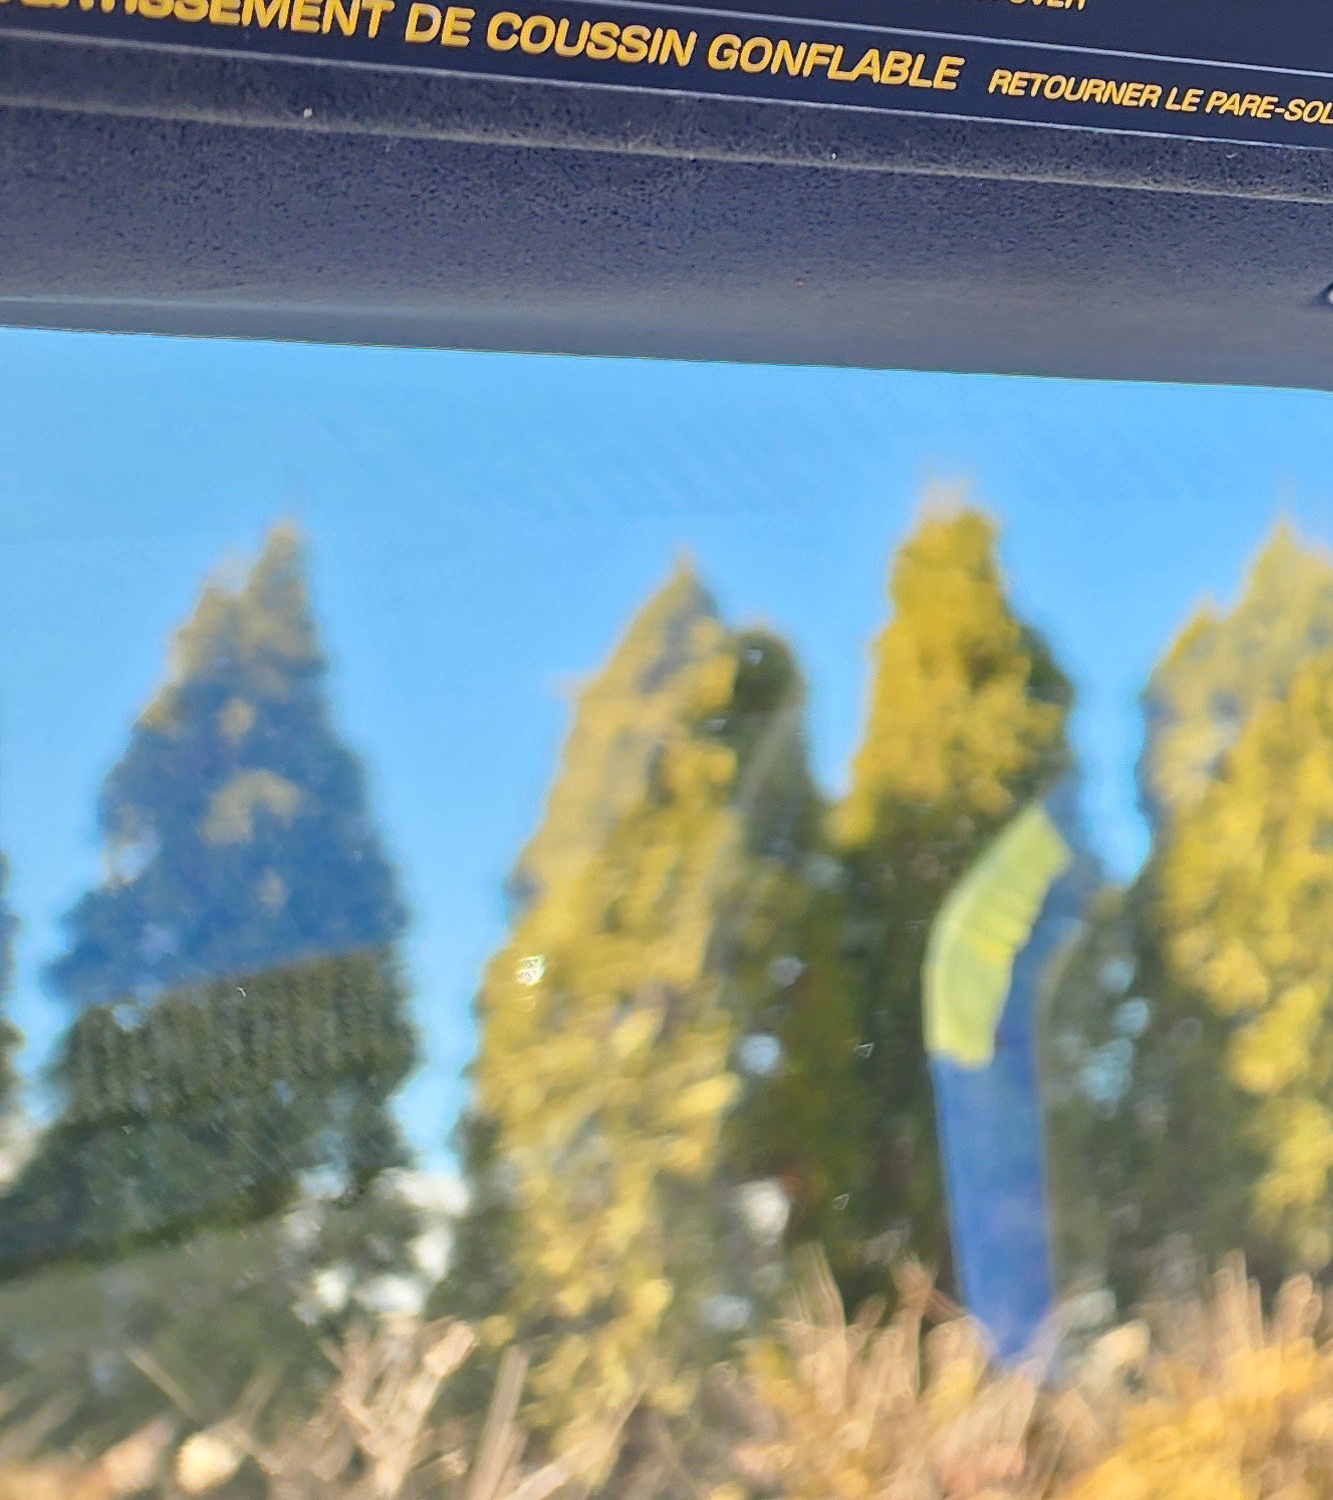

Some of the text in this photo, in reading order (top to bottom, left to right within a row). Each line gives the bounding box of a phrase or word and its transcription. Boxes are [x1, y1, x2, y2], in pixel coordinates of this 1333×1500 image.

[405, 2, 476, 48] DE
[486, 11, 697, 68] COUSSIN
[707, 33, 966, 91] GONFLABLE
[987, 68, 1160, 109] RETOURNER
[1164, 90, 1201, 113] LE
